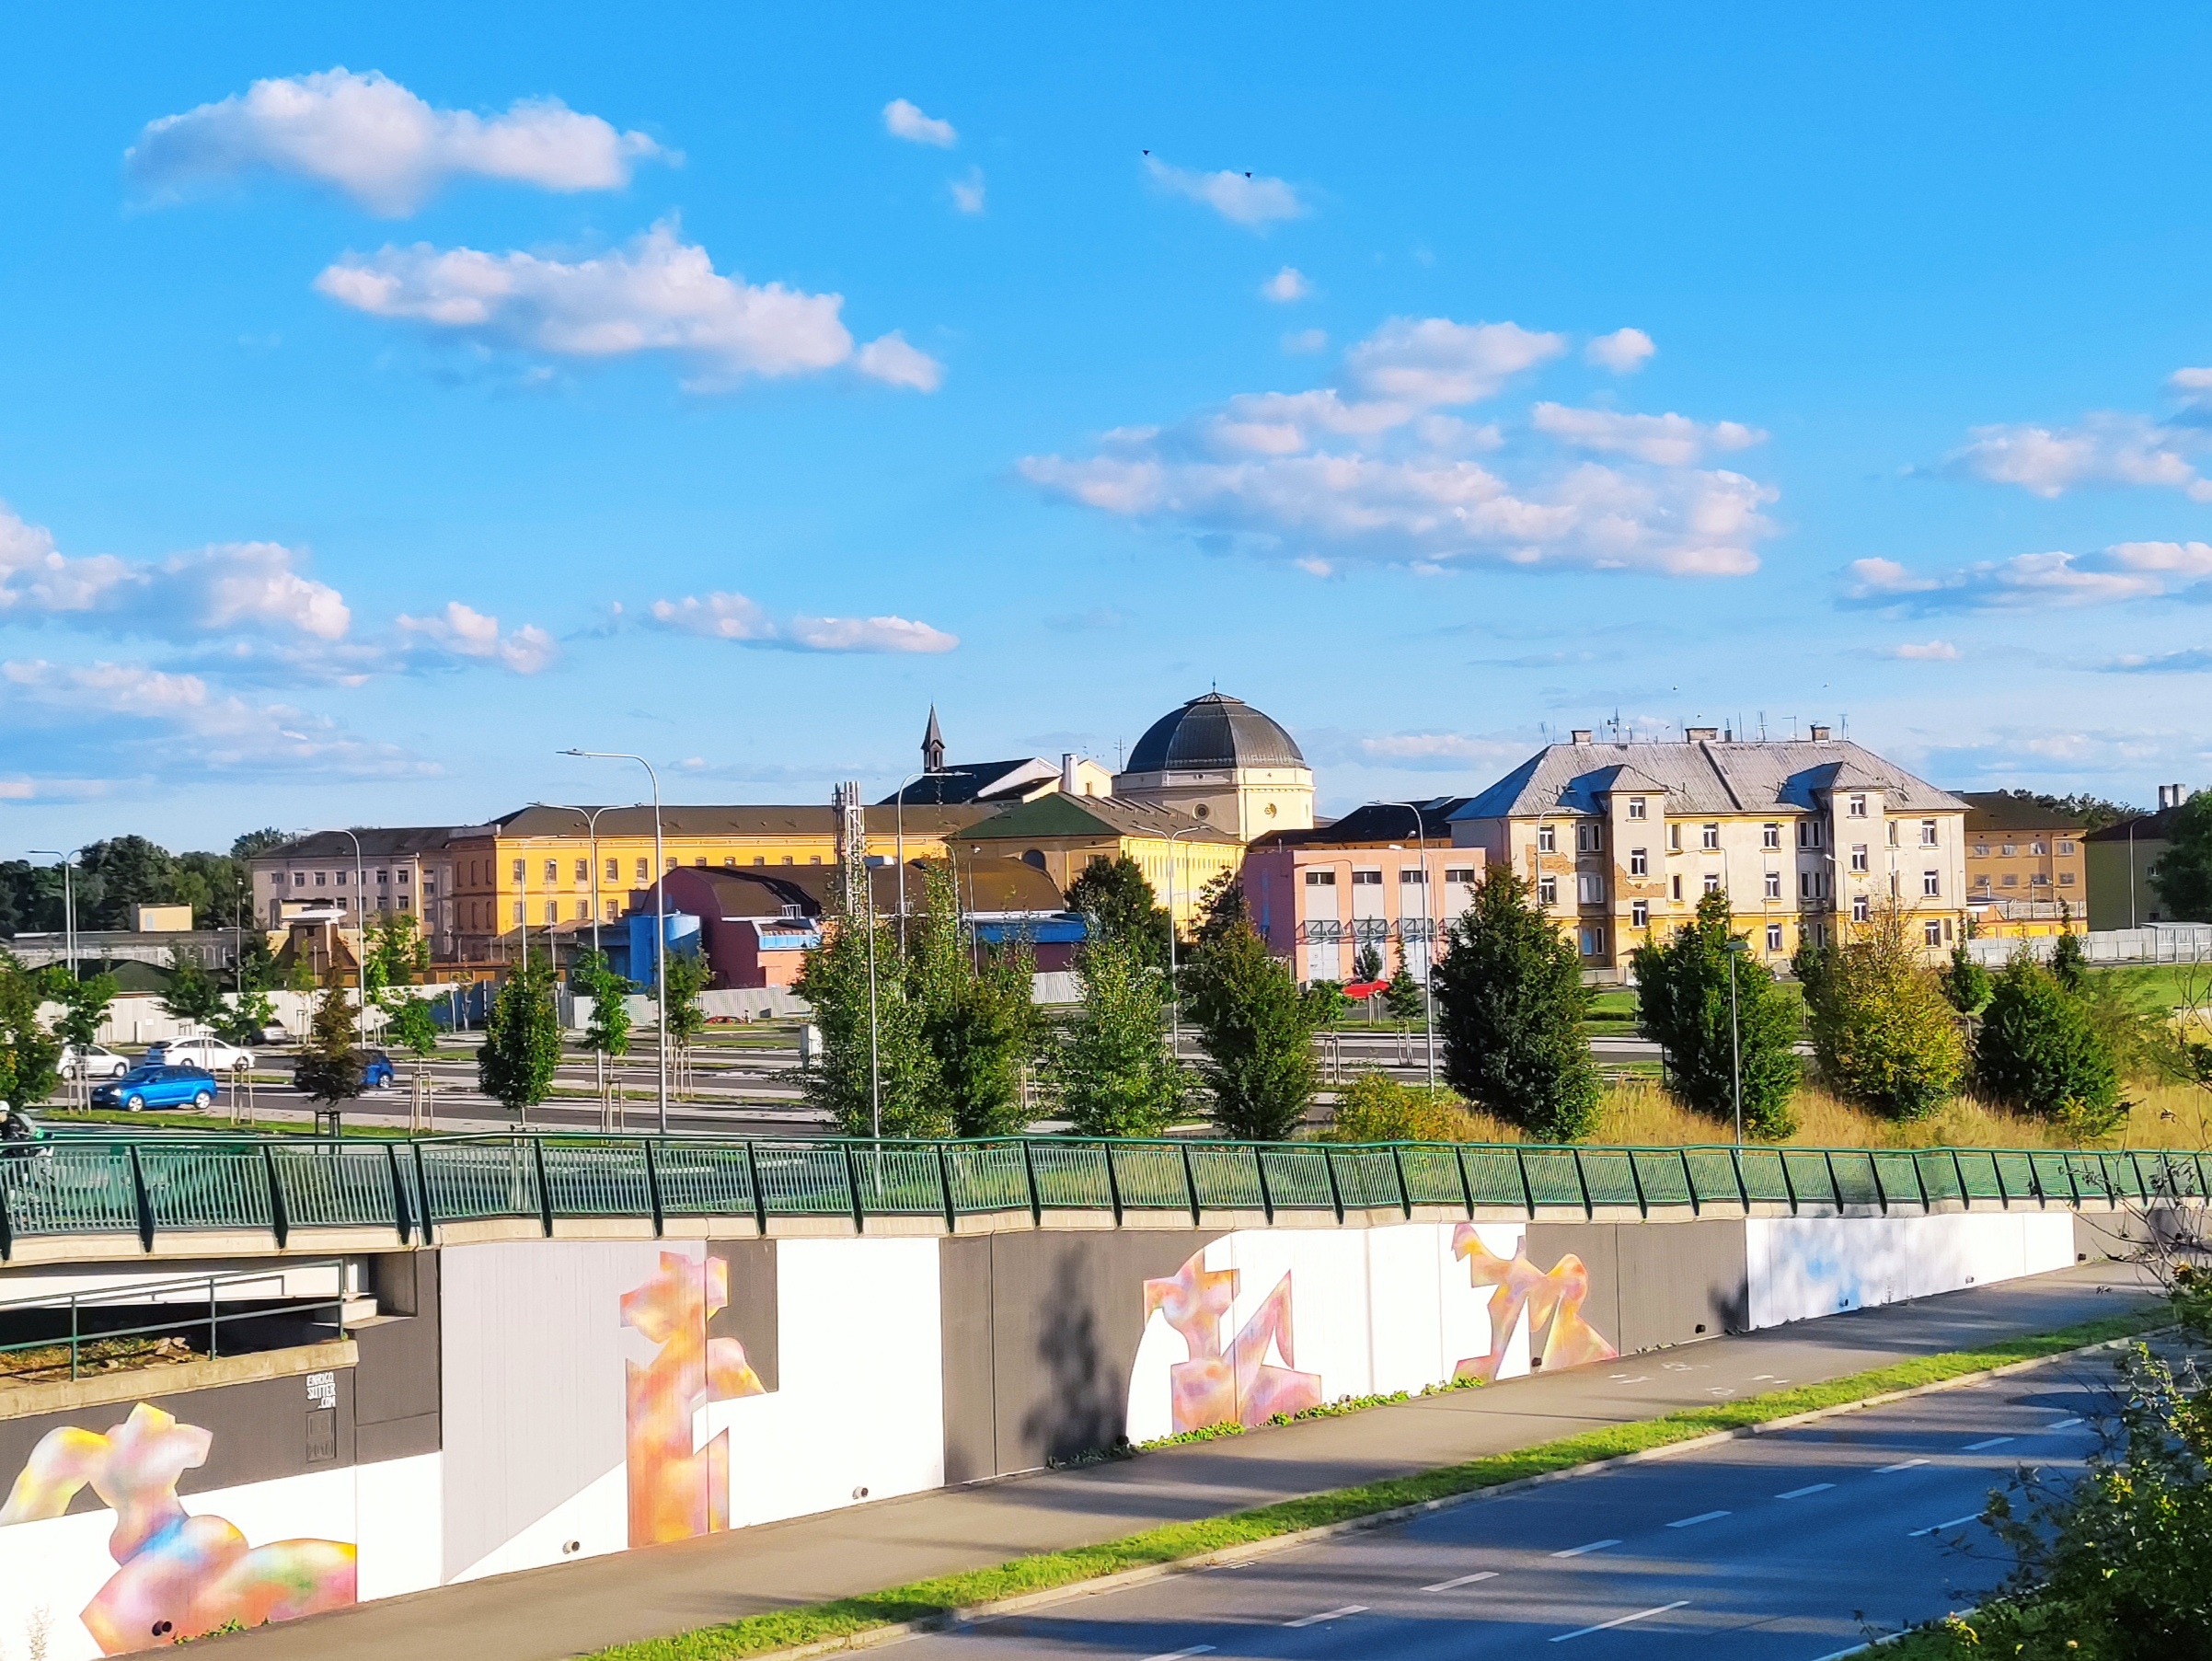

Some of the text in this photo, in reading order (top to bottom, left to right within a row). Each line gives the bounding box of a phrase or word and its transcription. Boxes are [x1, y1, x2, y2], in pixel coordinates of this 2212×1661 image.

[306, 1371, 334, 1387] ENRICO
[306, 1382, 336, 1400] SUTTER
[317, 1394, 336, 1408] .COM
